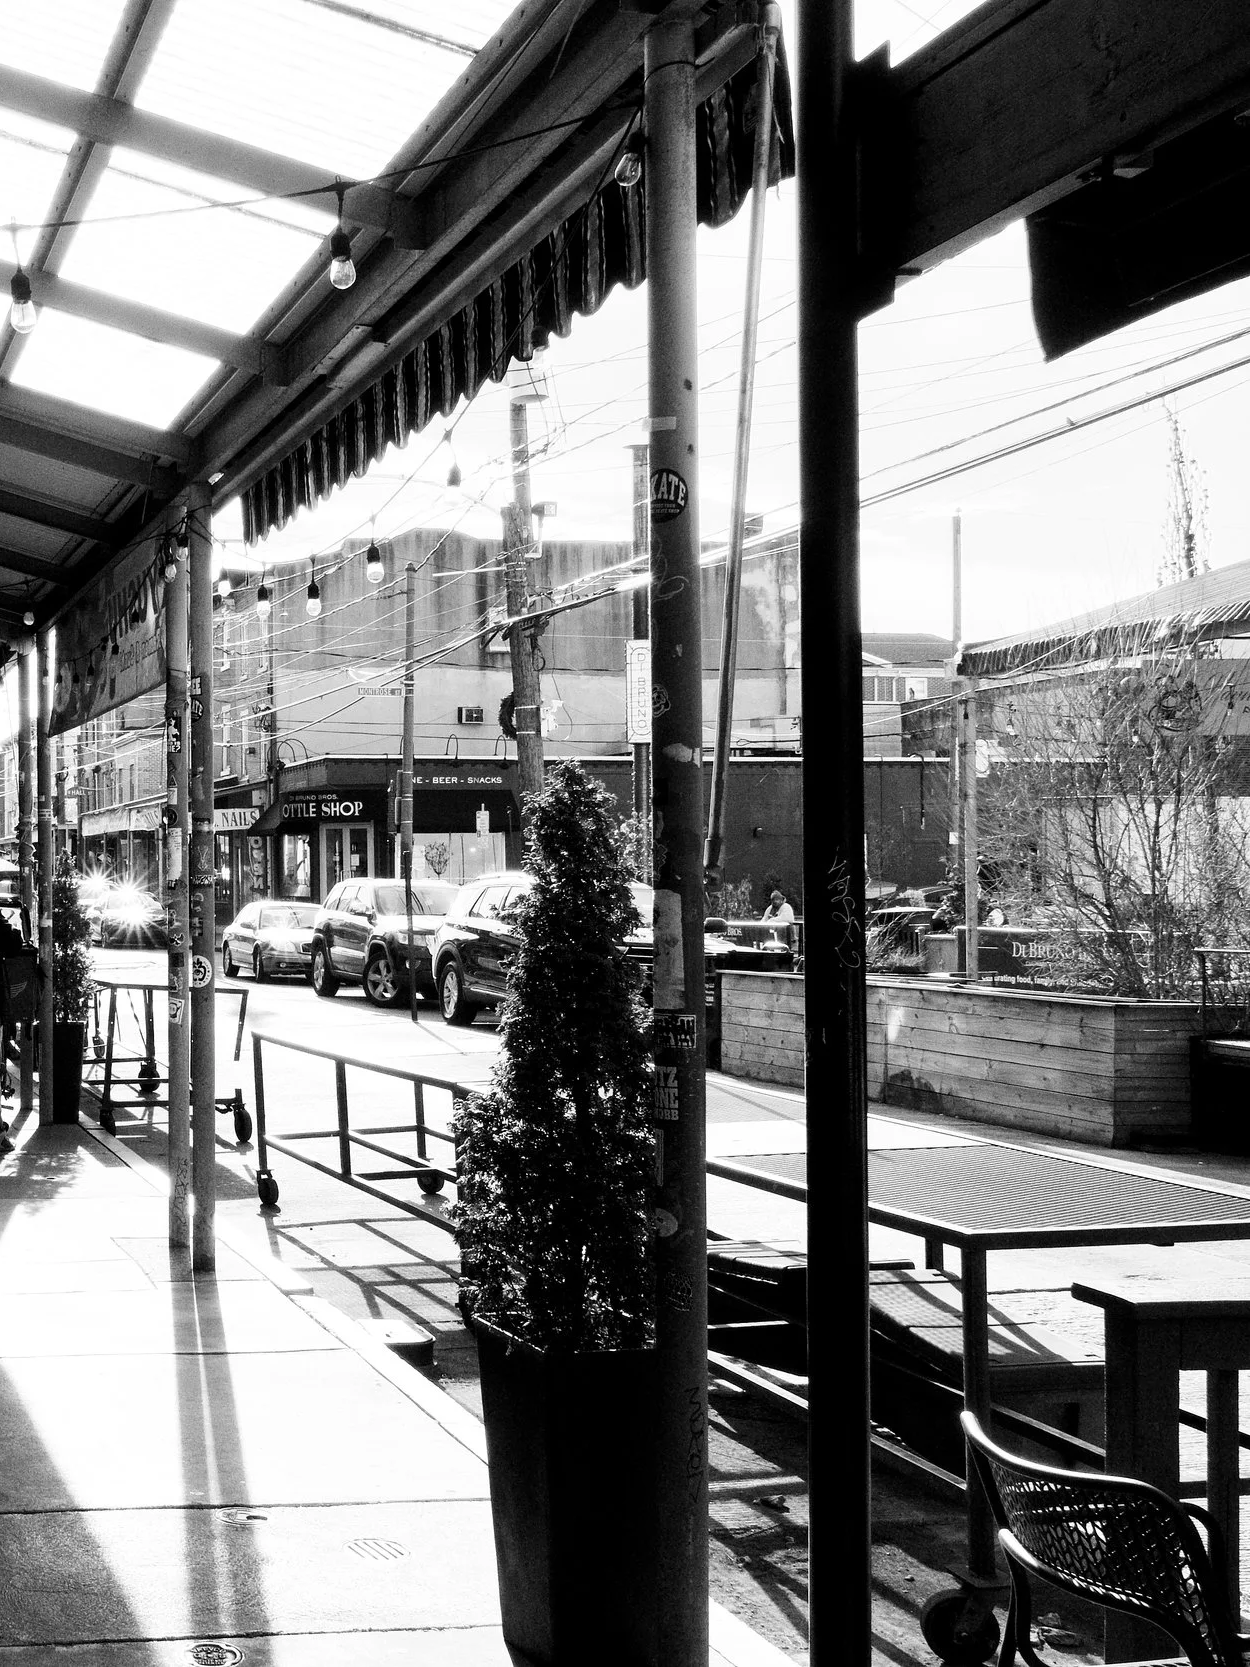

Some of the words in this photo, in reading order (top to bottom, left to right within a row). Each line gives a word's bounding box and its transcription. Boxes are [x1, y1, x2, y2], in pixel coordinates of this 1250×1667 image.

[650, 471, 686, 507] KATE
[359, 688, 392, 696] MONTROSE
[410, 776, 423, 784] NE
[432, 776, 458, 784] BEER
[467, 776, 503, 784] SNACKS
[282, 802, 317, 818] OTTLE
[321, 801, 364, 817] SHOP
[221, 810, 258, 828] NAILS
[654, 1066, 678, 1087] TZ
[653, 1108, 679, 1121] OBB
